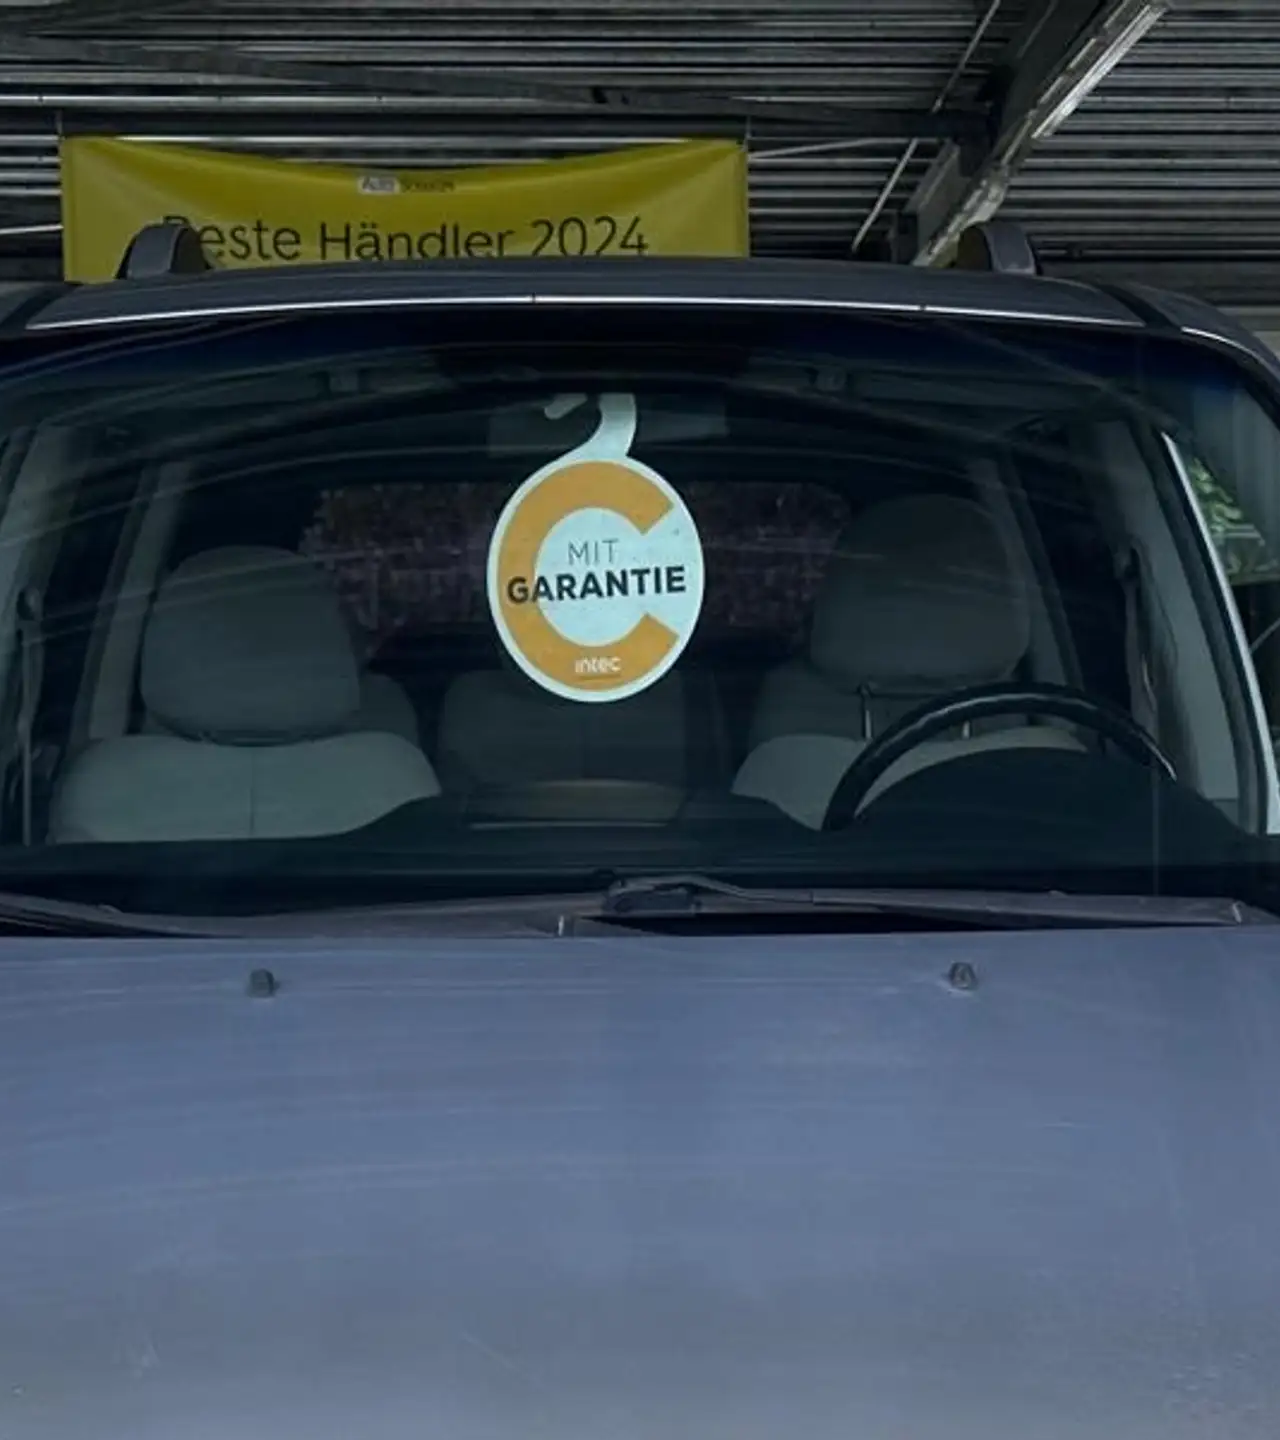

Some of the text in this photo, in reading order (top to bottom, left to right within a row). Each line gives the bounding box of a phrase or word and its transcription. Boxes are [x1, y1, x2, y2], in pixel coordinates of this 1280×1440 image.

[319, 220, 515, 261] Händler
[530, 214, 649, 258] 2024
[567, 537, 619, 566] MIT
[506, 564, 687, 604] GARANTIE
[575, 656, 621, 673] intec
